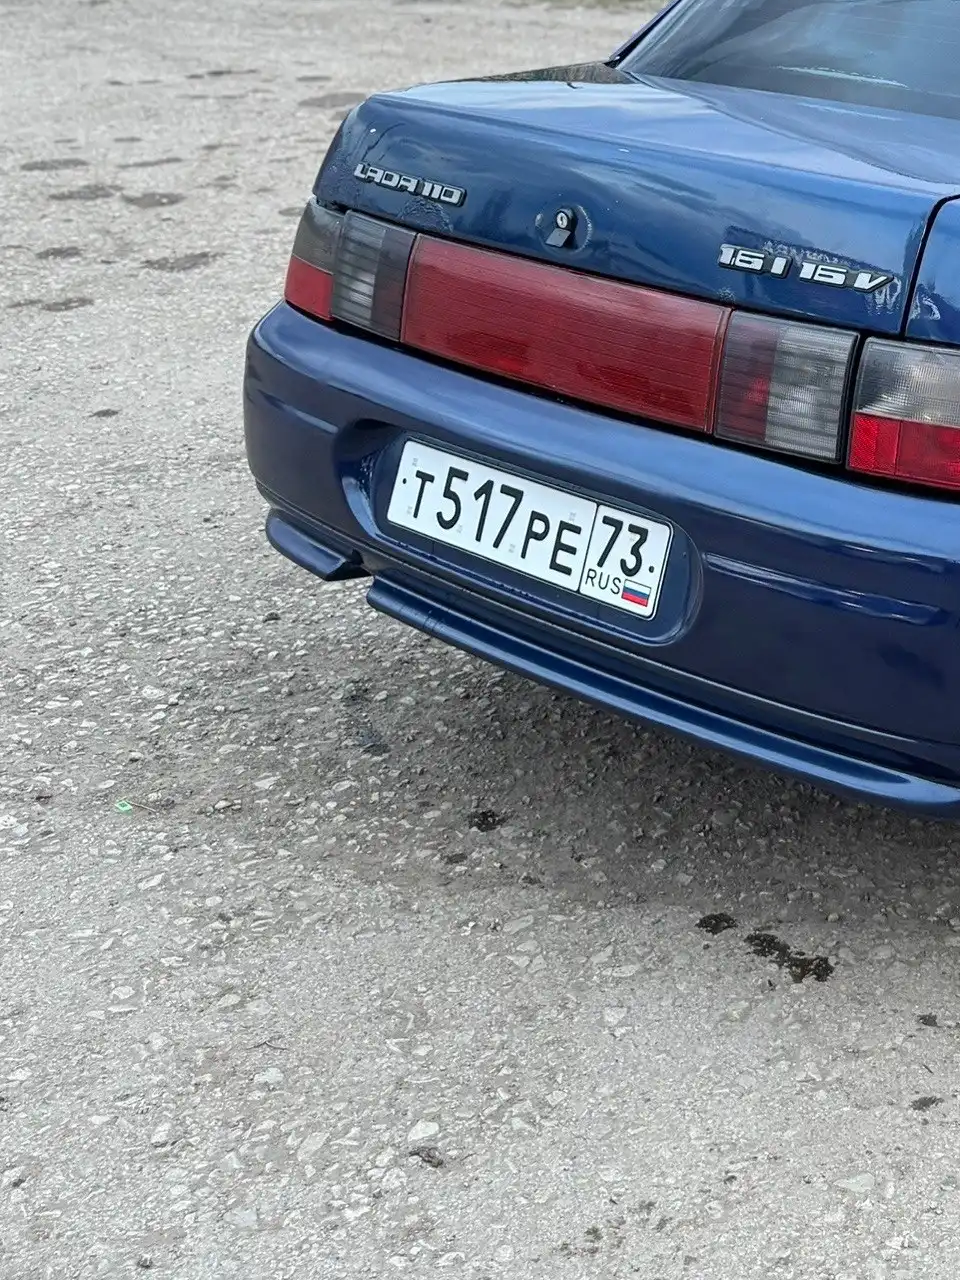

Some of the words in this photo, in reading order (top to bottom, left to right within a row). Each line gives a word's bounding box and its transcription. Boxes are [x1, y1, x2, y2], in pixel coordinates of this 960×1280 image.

[354, 163, 420, 193] LADA
[422, 181, 462, 204] 110
[799, 261, 848, 286] 16
[584, 568, 622, 595] RUS
